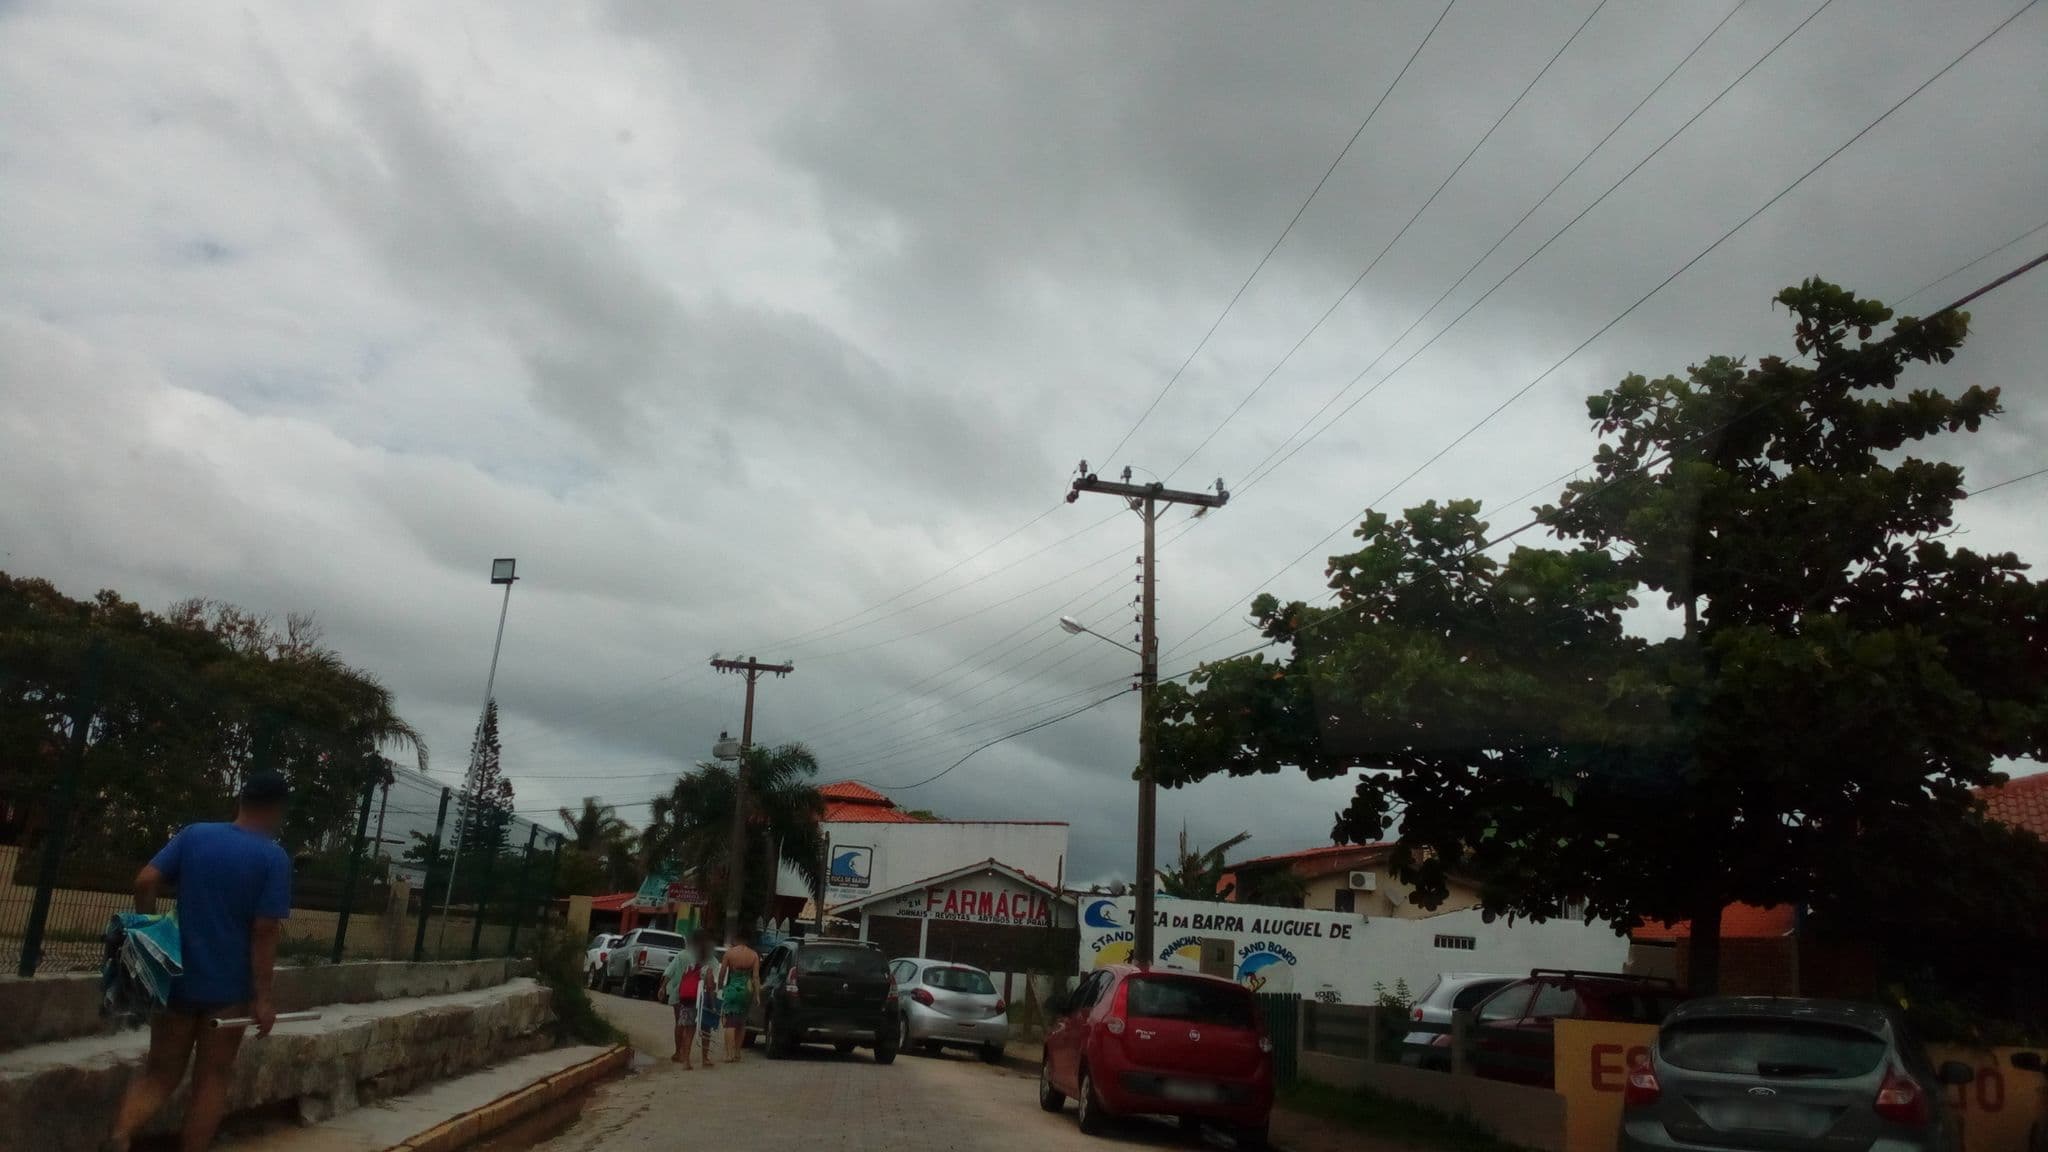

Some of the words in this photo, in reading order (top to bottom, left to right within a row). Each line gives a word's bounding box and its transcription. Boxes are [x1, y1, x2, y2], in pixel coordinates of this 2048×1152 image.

[926, 887, 1049, 920] FARMÁCIA
[896, 909, 928, 918] JORNAIS
[935, 912, 971, 921] REVISTAS
[978, 915, 1010, 924] ARTIGOS
[1013, 917, 1023, 925] DE
[1172, 915, 1188, 928] DA
[1192, 914, 1244, 932] BARRA
[1251, 918, 1322, 938] ALUGUEL
[1329, 923, 1352, 939] DE
[1091, 931, 1134, 953] STAND
[1159, 935, 1202, 961] PRANCHAS
[1238, 941, 1265, 959] SAND
[1268, 941, 1297, 966] BOARD
